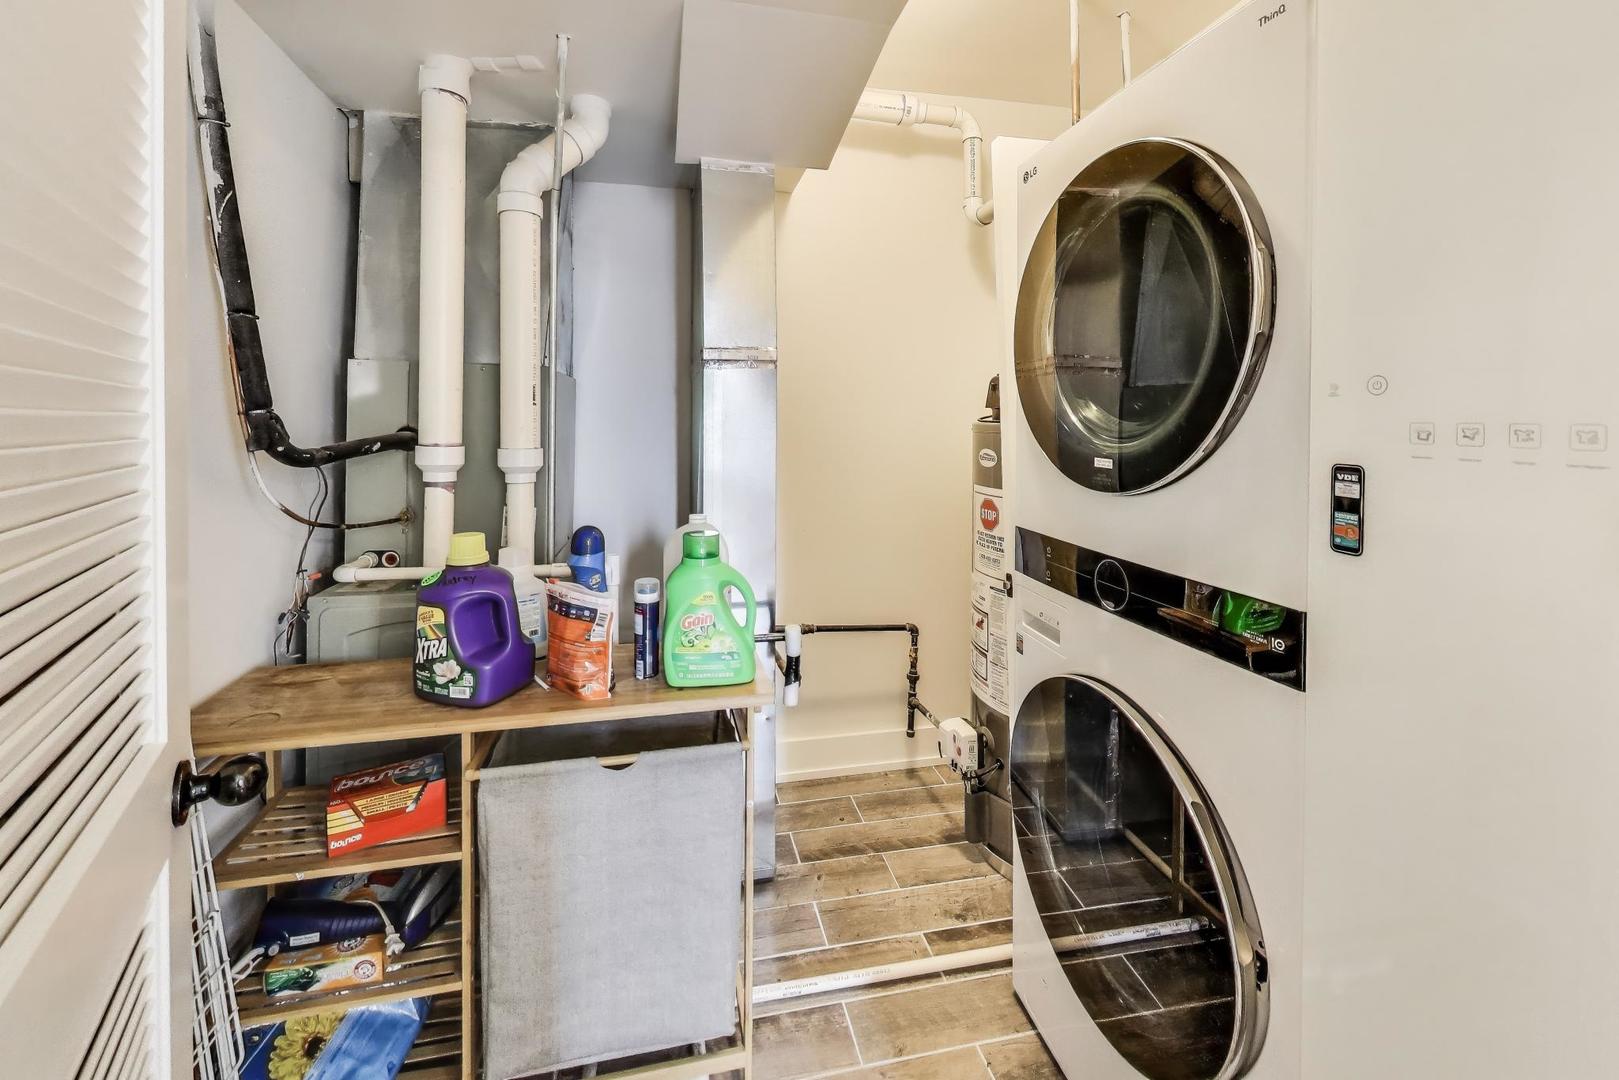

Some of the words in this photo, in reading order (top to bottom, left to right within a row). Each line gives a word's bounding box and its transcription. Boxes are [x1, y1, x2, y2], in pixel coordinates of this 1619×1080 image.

[1257, 4, 1287, 28] ThinQ
[1029, 166, 1037, 178] LG
[1336, 473, 1359, 482] VDE
[980, 507, 997, 522] STOP
[681, 612, 714, 631] Gain
[415, 637, 448, 664] XTRA
[334, 759, 426, 792] bounce
[330, 833, 362, 849] bounce
